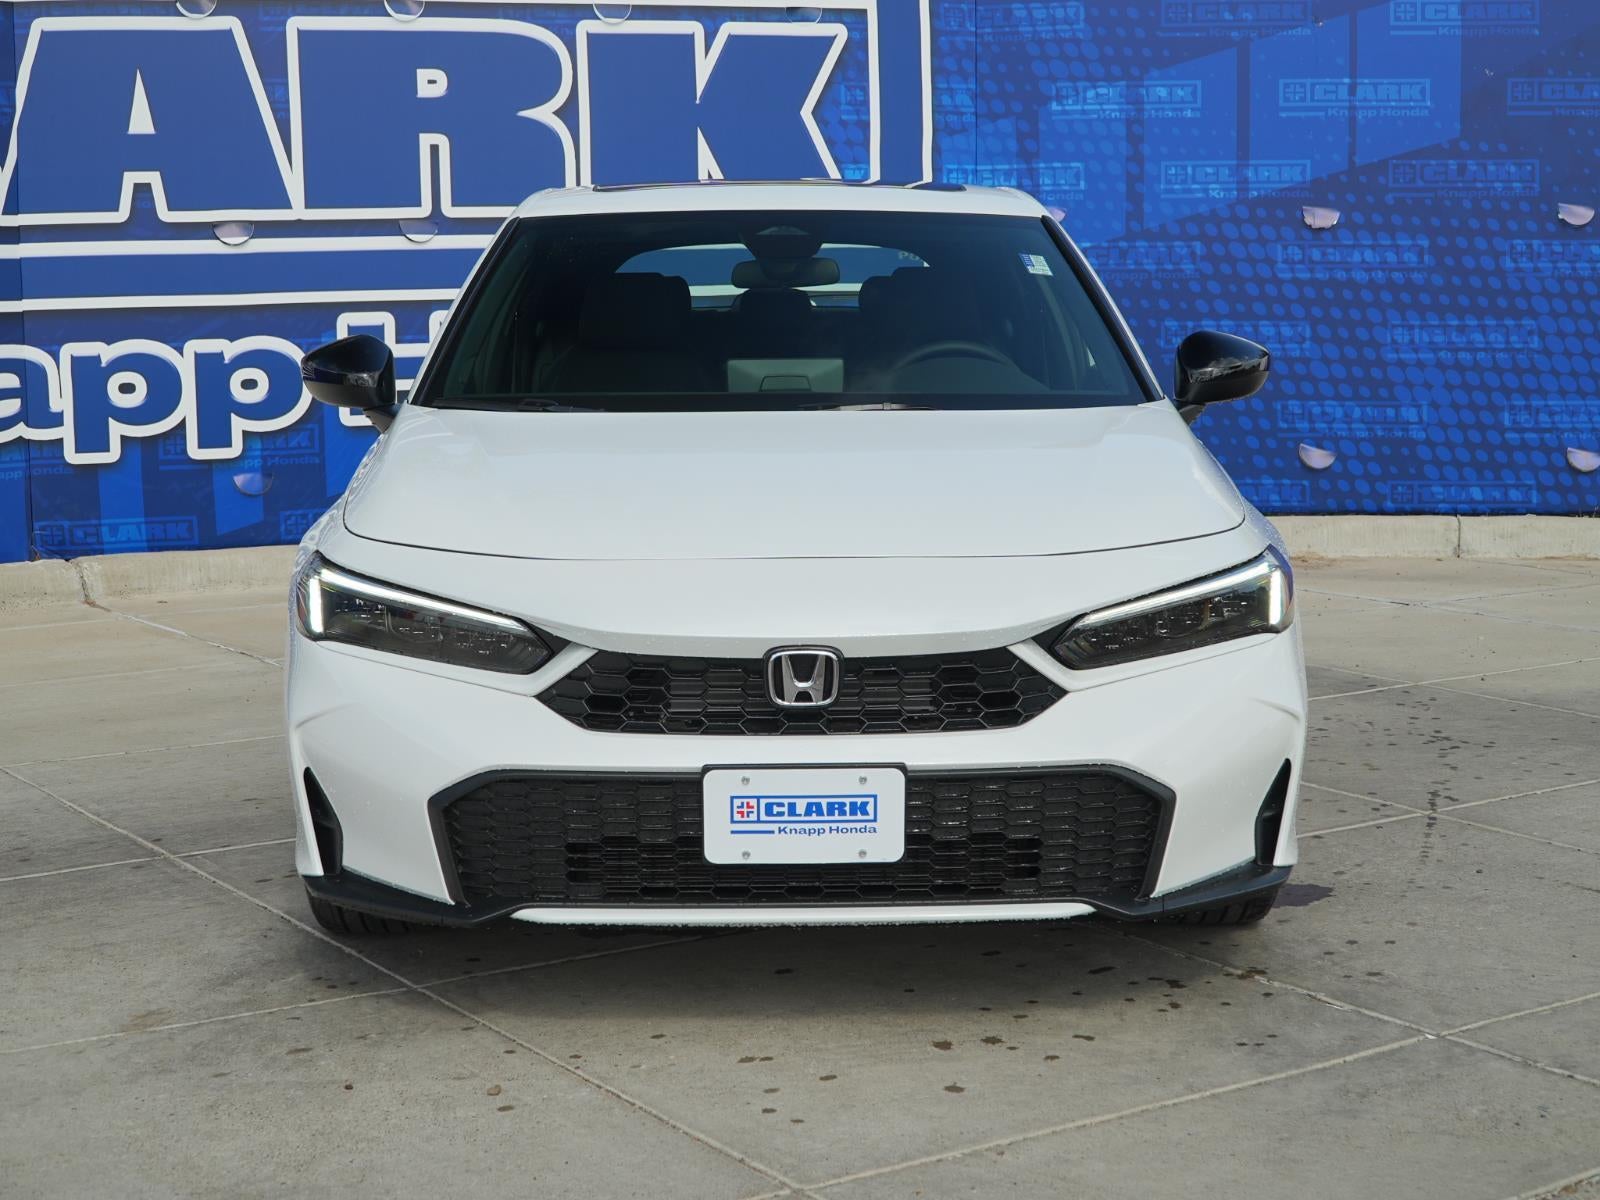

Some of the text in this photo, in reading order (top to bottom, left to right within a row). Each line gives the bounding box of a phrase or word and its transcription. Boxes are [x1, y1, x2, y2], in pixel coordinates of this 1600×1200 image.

[1424, 3, 1533, 19] CLARK
[1086, 87, 1194, 103] CLARK
[1313, 84, 1424, 100] CLARK
[1151, 108, 1200, 118] Honda
[1327, 107, 1430, 119] Knapp Honda
[1195, 166, 1304, 182] CLARK
[1423, 166, 1533, 181] CLARK
[73, 521, 191, 544] CLARK
[764, 800, 871, 818] CLARK
[777, 825, 878, 837] Knapp Honda
